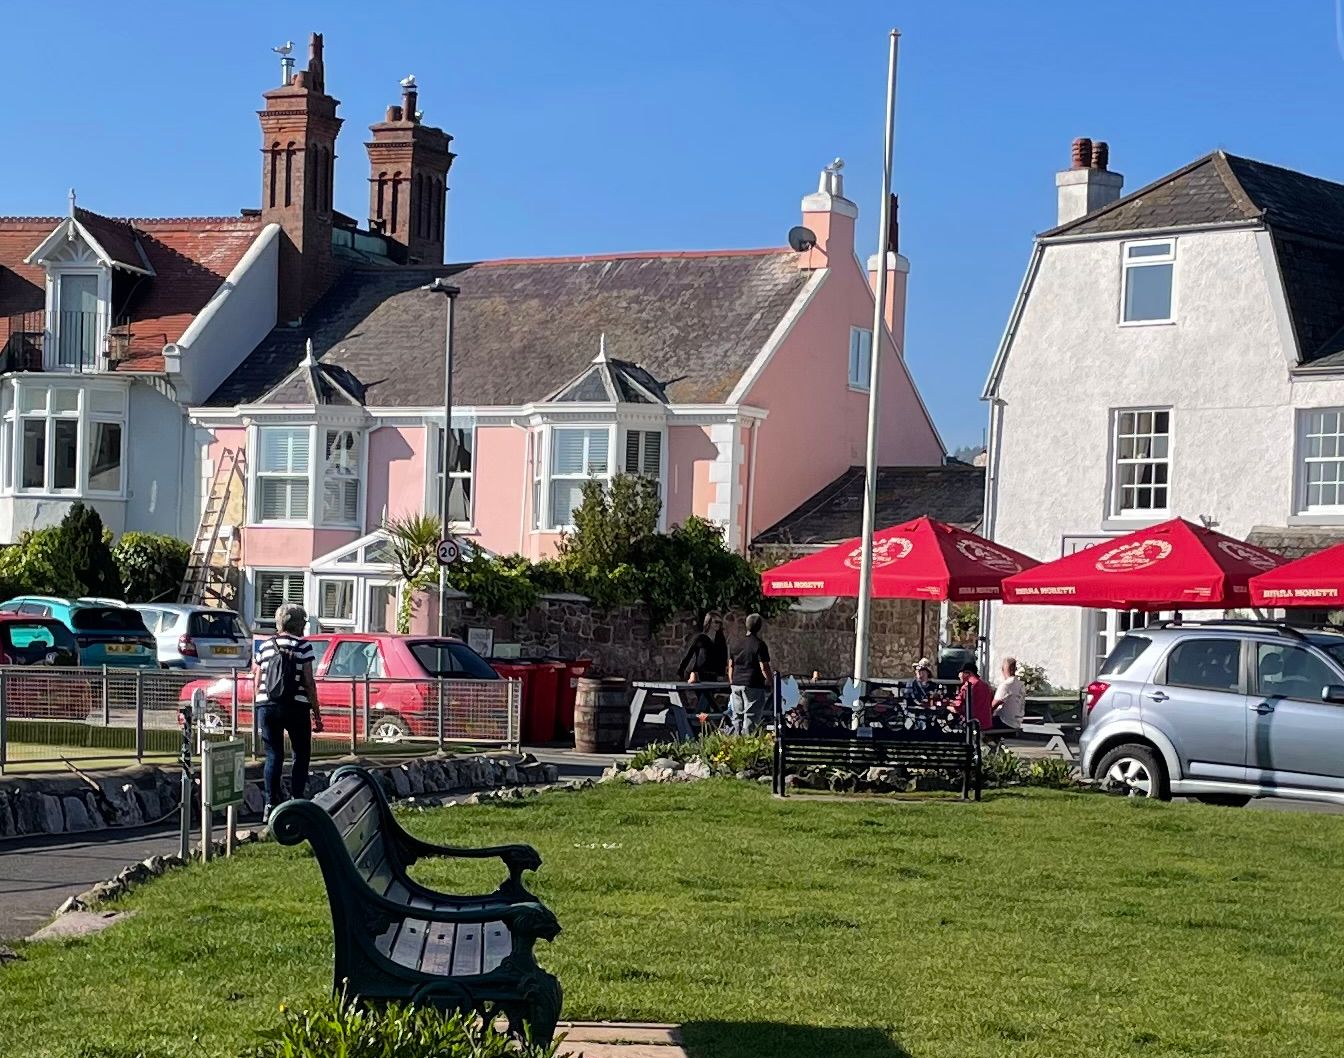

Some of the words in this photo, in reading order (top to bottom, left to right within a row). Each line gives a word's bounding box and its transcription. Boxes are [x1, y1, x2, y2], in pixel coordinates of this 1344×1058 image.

[440, 547, 456, 557] 20
[1262, 589, 1294, 598] BIRRA
[1294, 588, 1338, 597] MORETTI
